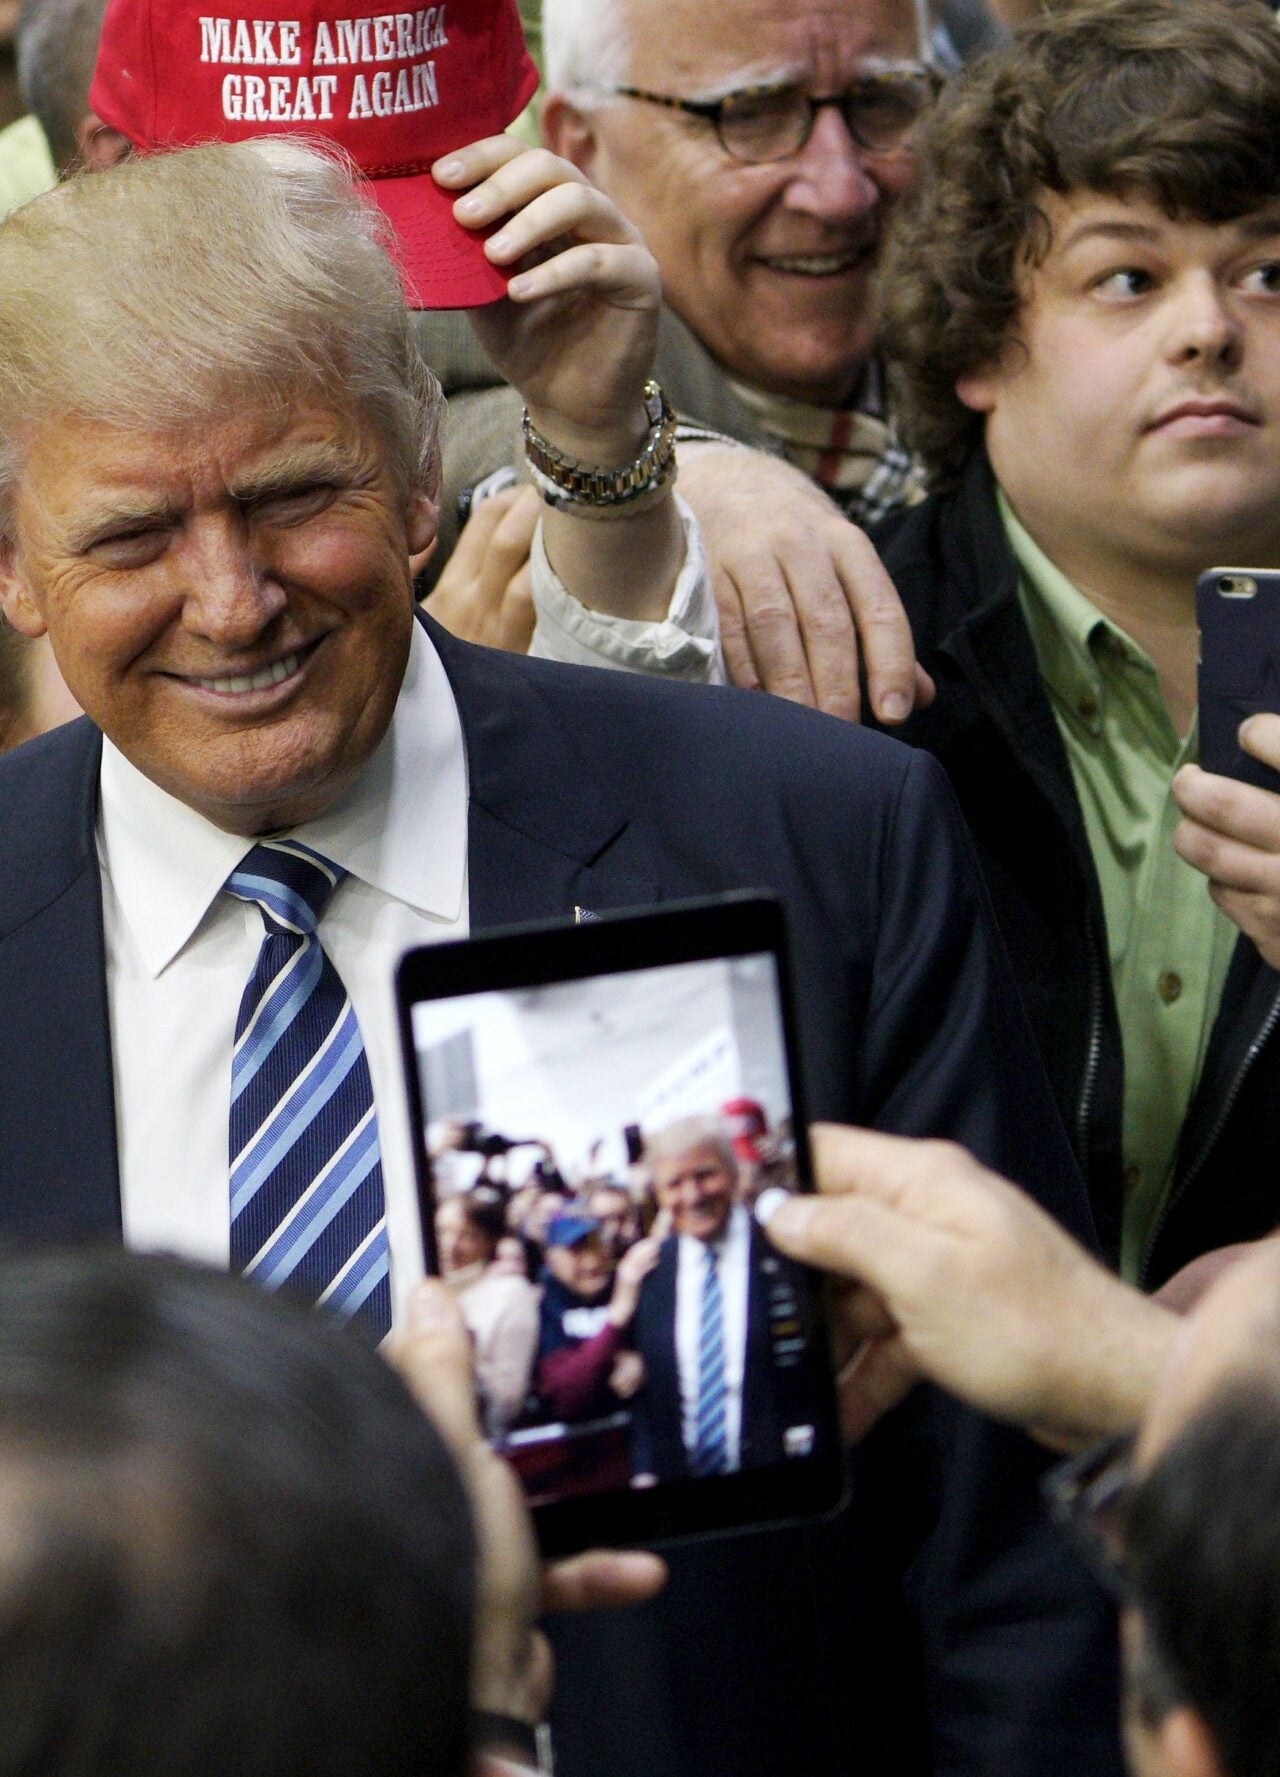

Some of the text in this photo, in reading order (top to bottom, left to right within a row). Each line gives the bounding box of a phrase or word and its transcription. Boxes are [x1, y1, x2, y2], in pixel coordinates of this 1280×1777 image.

[199, 5, 449, 66] MAKE AMERICA
[222, 60, 440, 121] GREAT AGAIN
